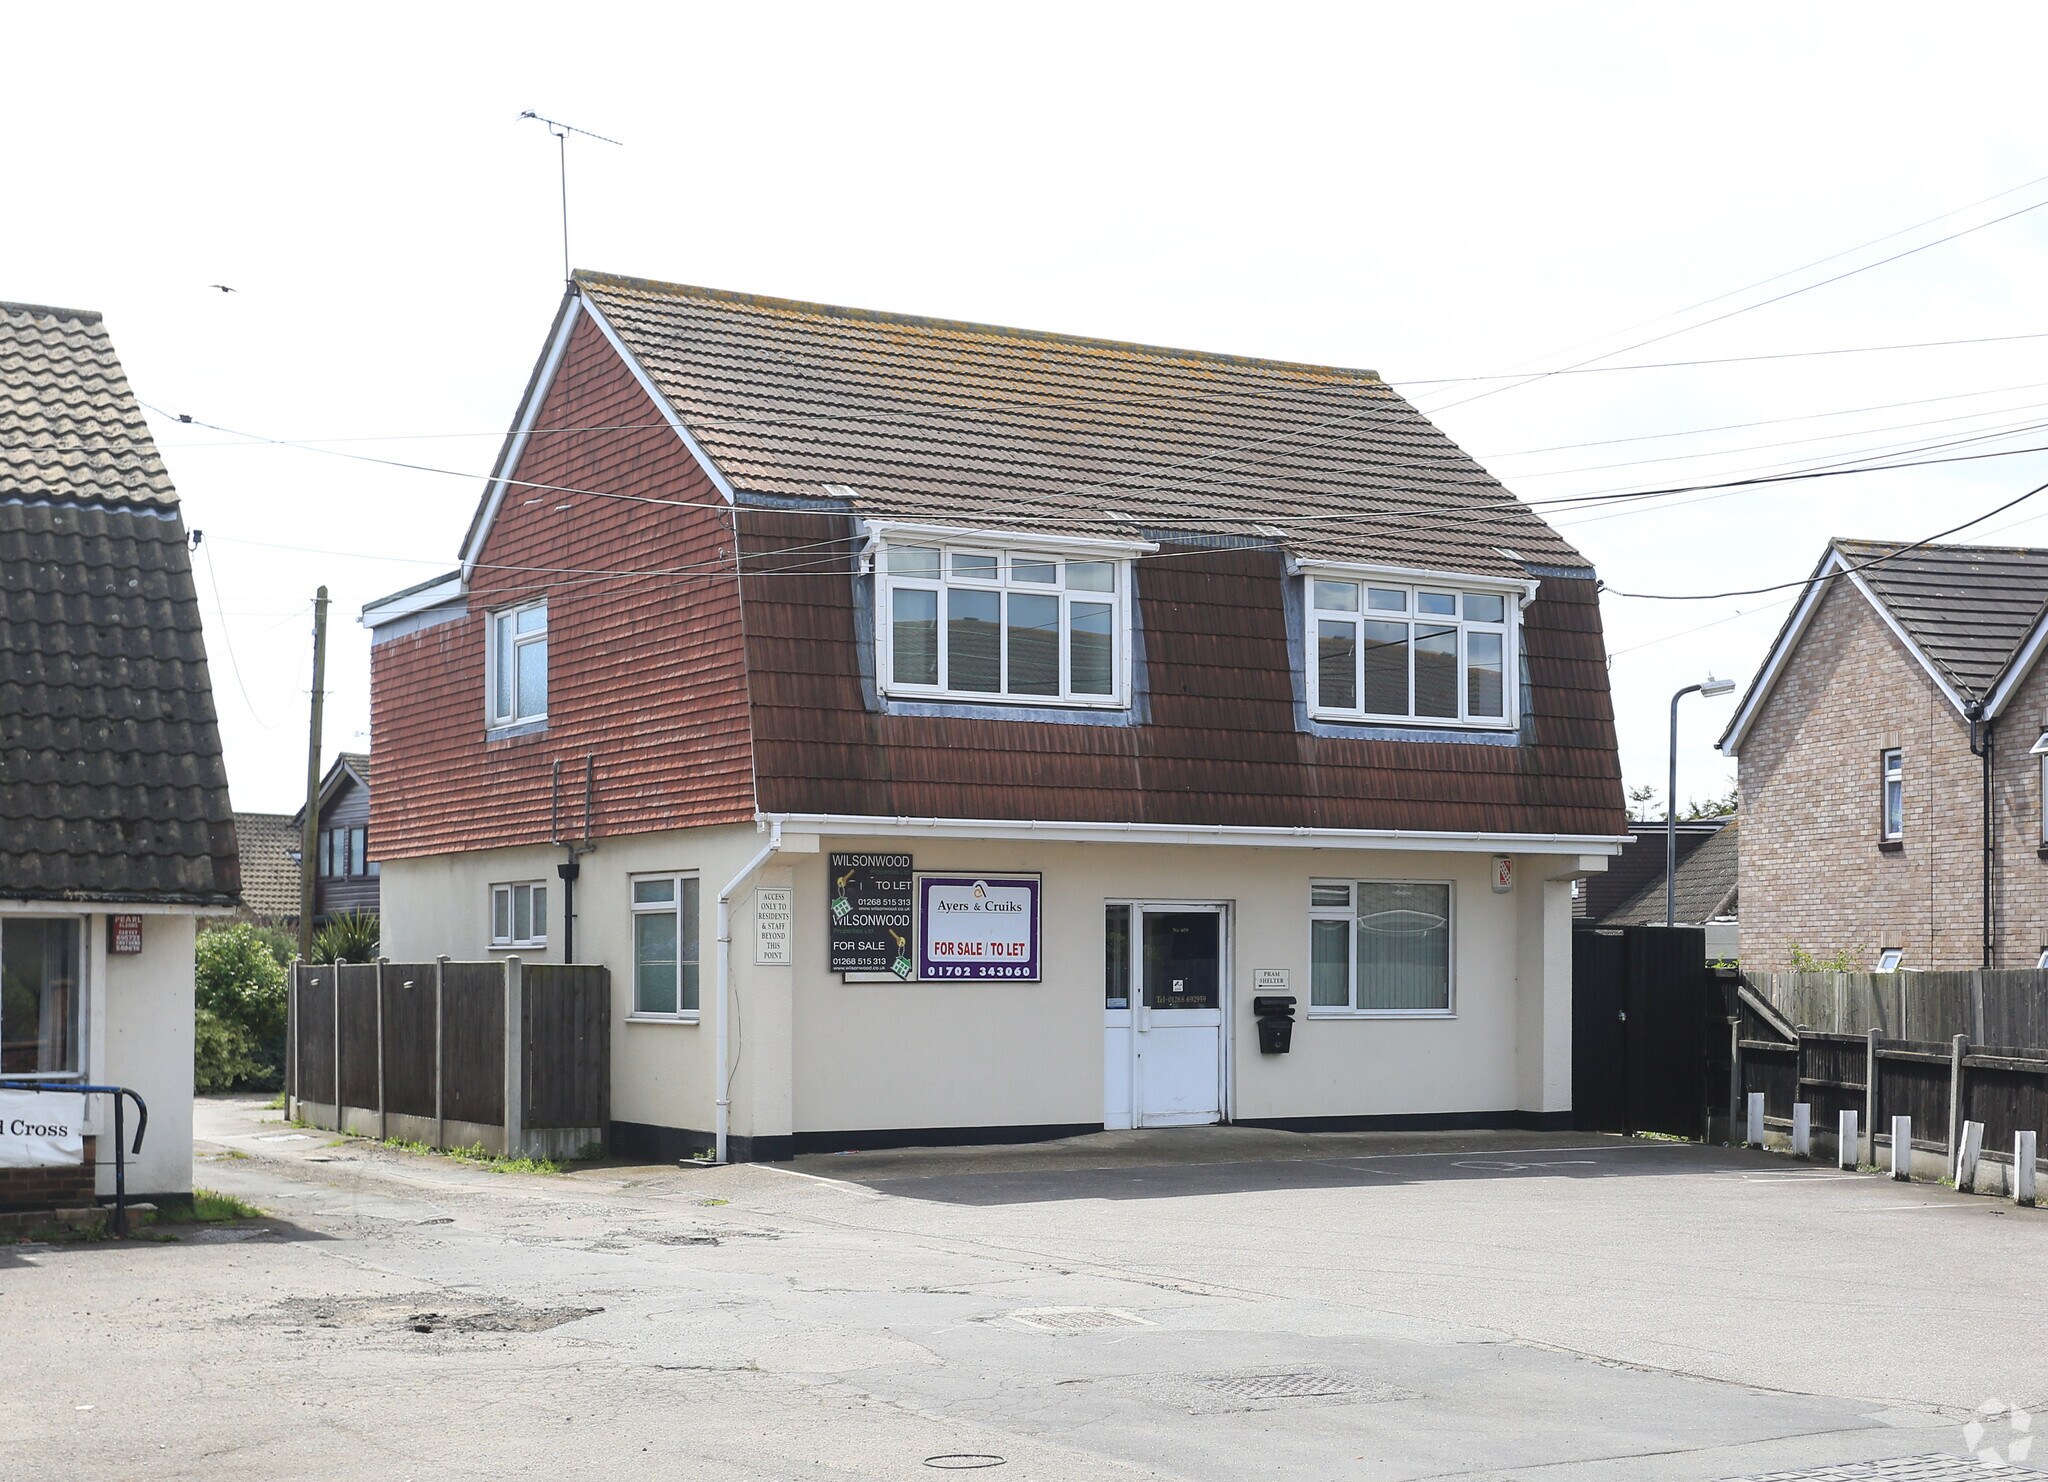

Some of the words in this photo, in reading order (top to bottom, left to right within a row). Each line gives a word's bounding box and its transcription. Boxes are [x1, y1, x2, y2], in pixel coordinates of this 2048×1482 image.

[832, 854, 910, 867] WILSONWOOD
[875, 881, 890, 890] TO
[893, 881, 912, 890] LET
[858, 898, 880, 906] 01268
[883, 898, 896, 906] 515
[898, 898, 911, 906] 313
[937, 900, 969, 914] Ayers
[973, 902, 981, 911] &
[985, 900, 1022, 912] Cruiks
[115, 915, 141, 923] PEARL
[758, 912, 789, 920] RESIDENTS
[832, 914, 910, 926] WILSONWOOD
[833, 941, 856, 950] FOR
[858, 941, 885, 950] SALE
[934, 942, 955, 956] FOR
[957, 942, 983, 956] SALE
[991, 942, 1004, 956] TO
[1007, 943, 1025, 956] LET
[928, 966, 971, 976] 01702
[979, 967, 1030, 976] 343060
[10, 1119, 68, 1137] Cross
